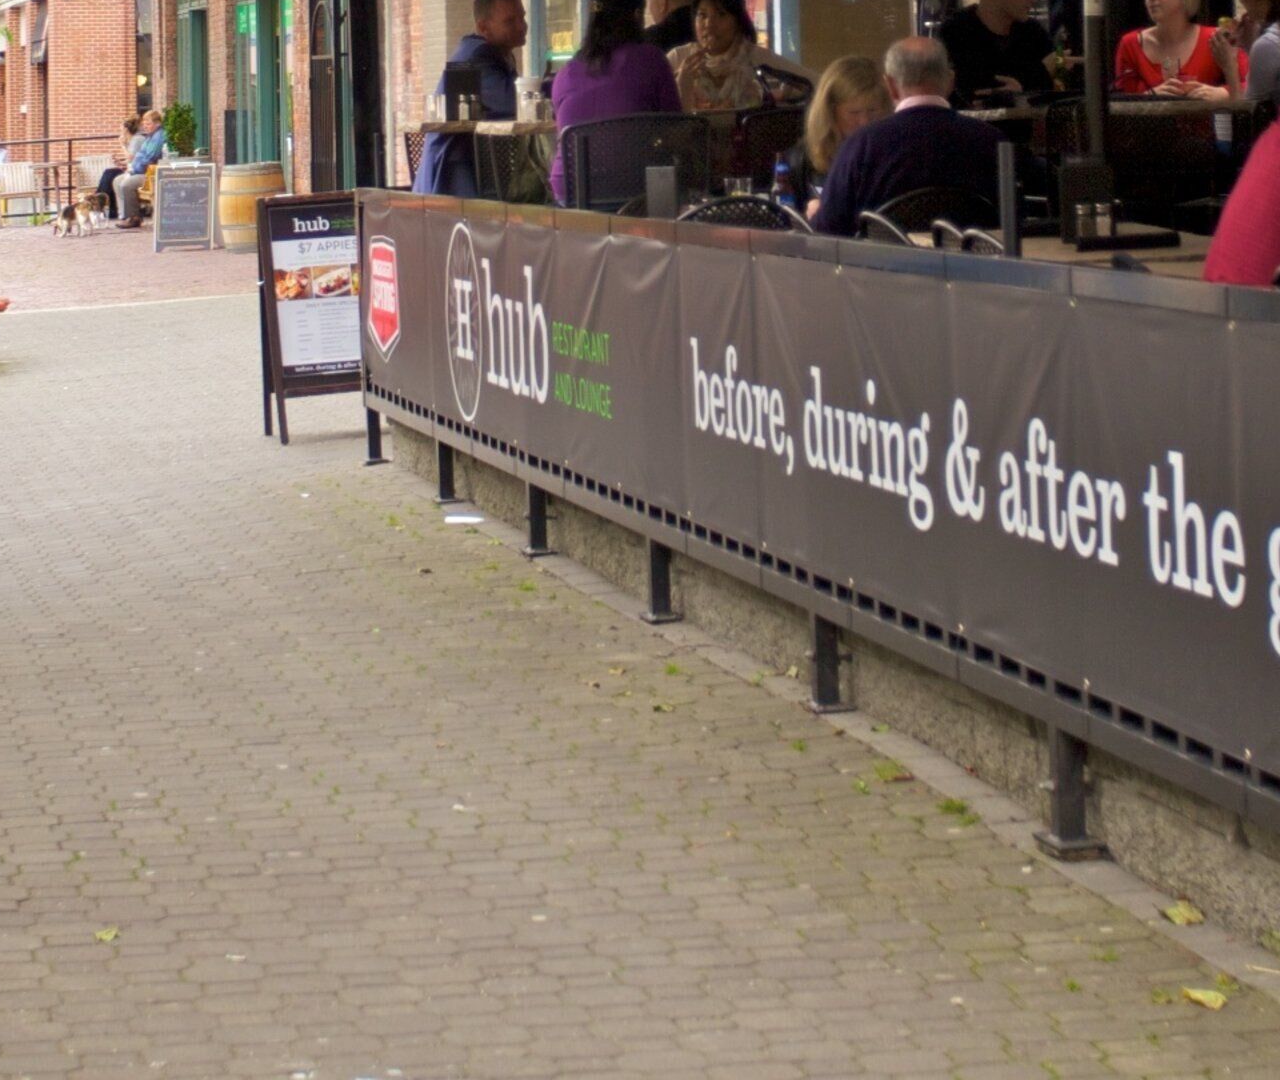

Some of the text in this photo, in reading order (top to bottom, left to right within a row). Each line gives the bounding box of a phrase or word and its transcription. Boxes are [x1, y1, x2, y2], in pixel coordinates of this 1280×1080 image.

[293, 216, 330, 233] hub
[298, 238, 358, 255] $7 APPIES
[482, 257, 548, 404] hub
[552, 322, 610, 366] RESTAURANT
[554, 372, 613, 420] AND LOUNGE
[690, 337, 794, 476] before,
[804, 367, 934, 531] during
[945, 398, 985, 522] &
[998, 418, 1126, 567] after
[1144, 451, 1246, 608] the
